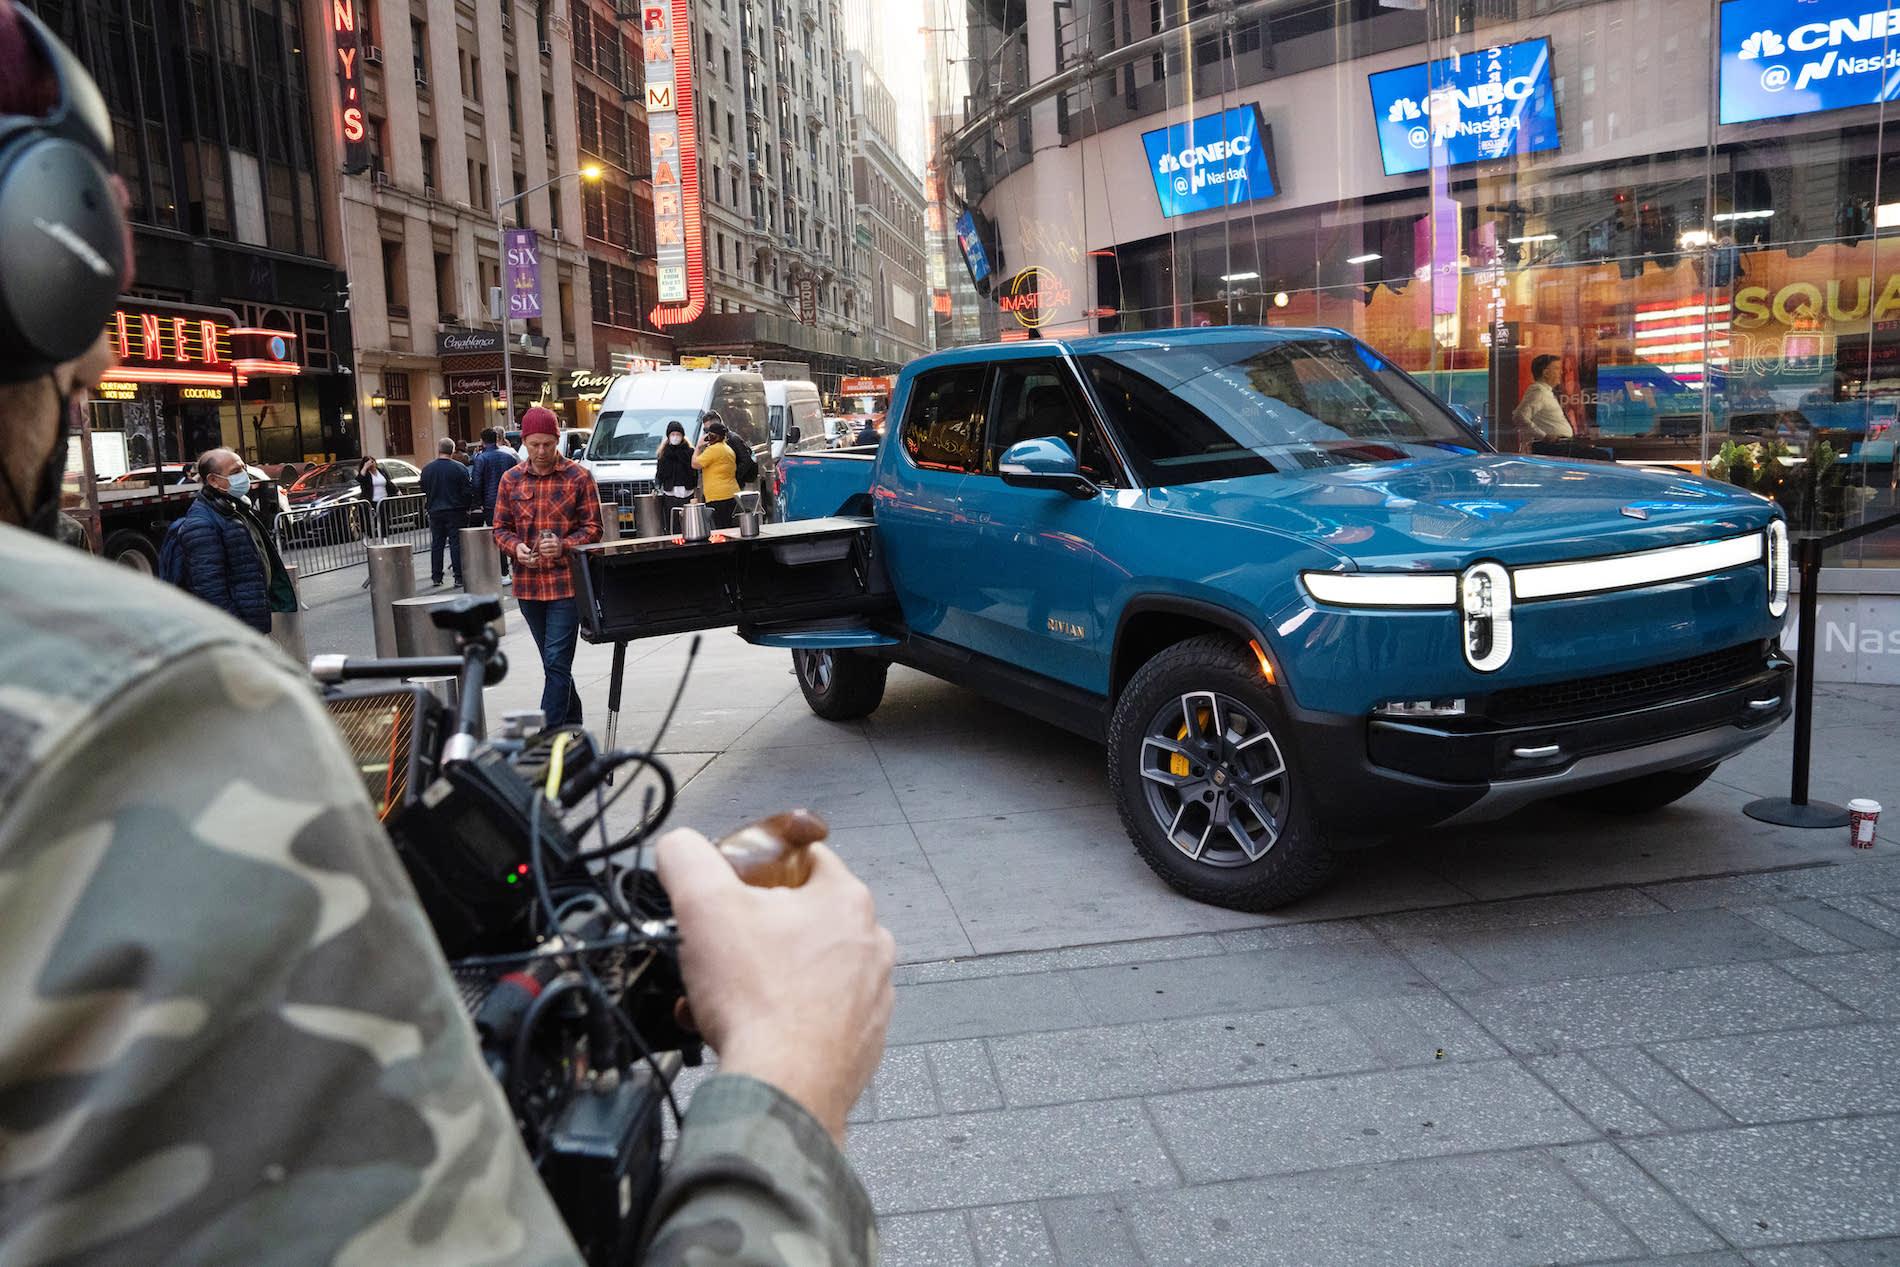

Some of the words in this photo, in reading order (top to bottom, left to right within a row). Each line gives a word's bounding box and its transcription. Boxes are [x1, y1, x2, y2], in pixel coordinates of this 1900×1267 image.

[644, 6, 669, 63] RK
[1420, 76, 1535, 116] CNBC
[1461, 114, 1521, 136] Nasdaq
[1179, 135, 1252, 168] CNBC
[653, 132, 680, 245] PARK
[1206, 167, 1248, 185] Nasdaq
[116, 311, 219, 364] INER
[444, 335, 496, 349] Casablanca
[184, 388, 222, 399] COCKTAILS
[1047, 617, 1085, 639] RIVIAN
